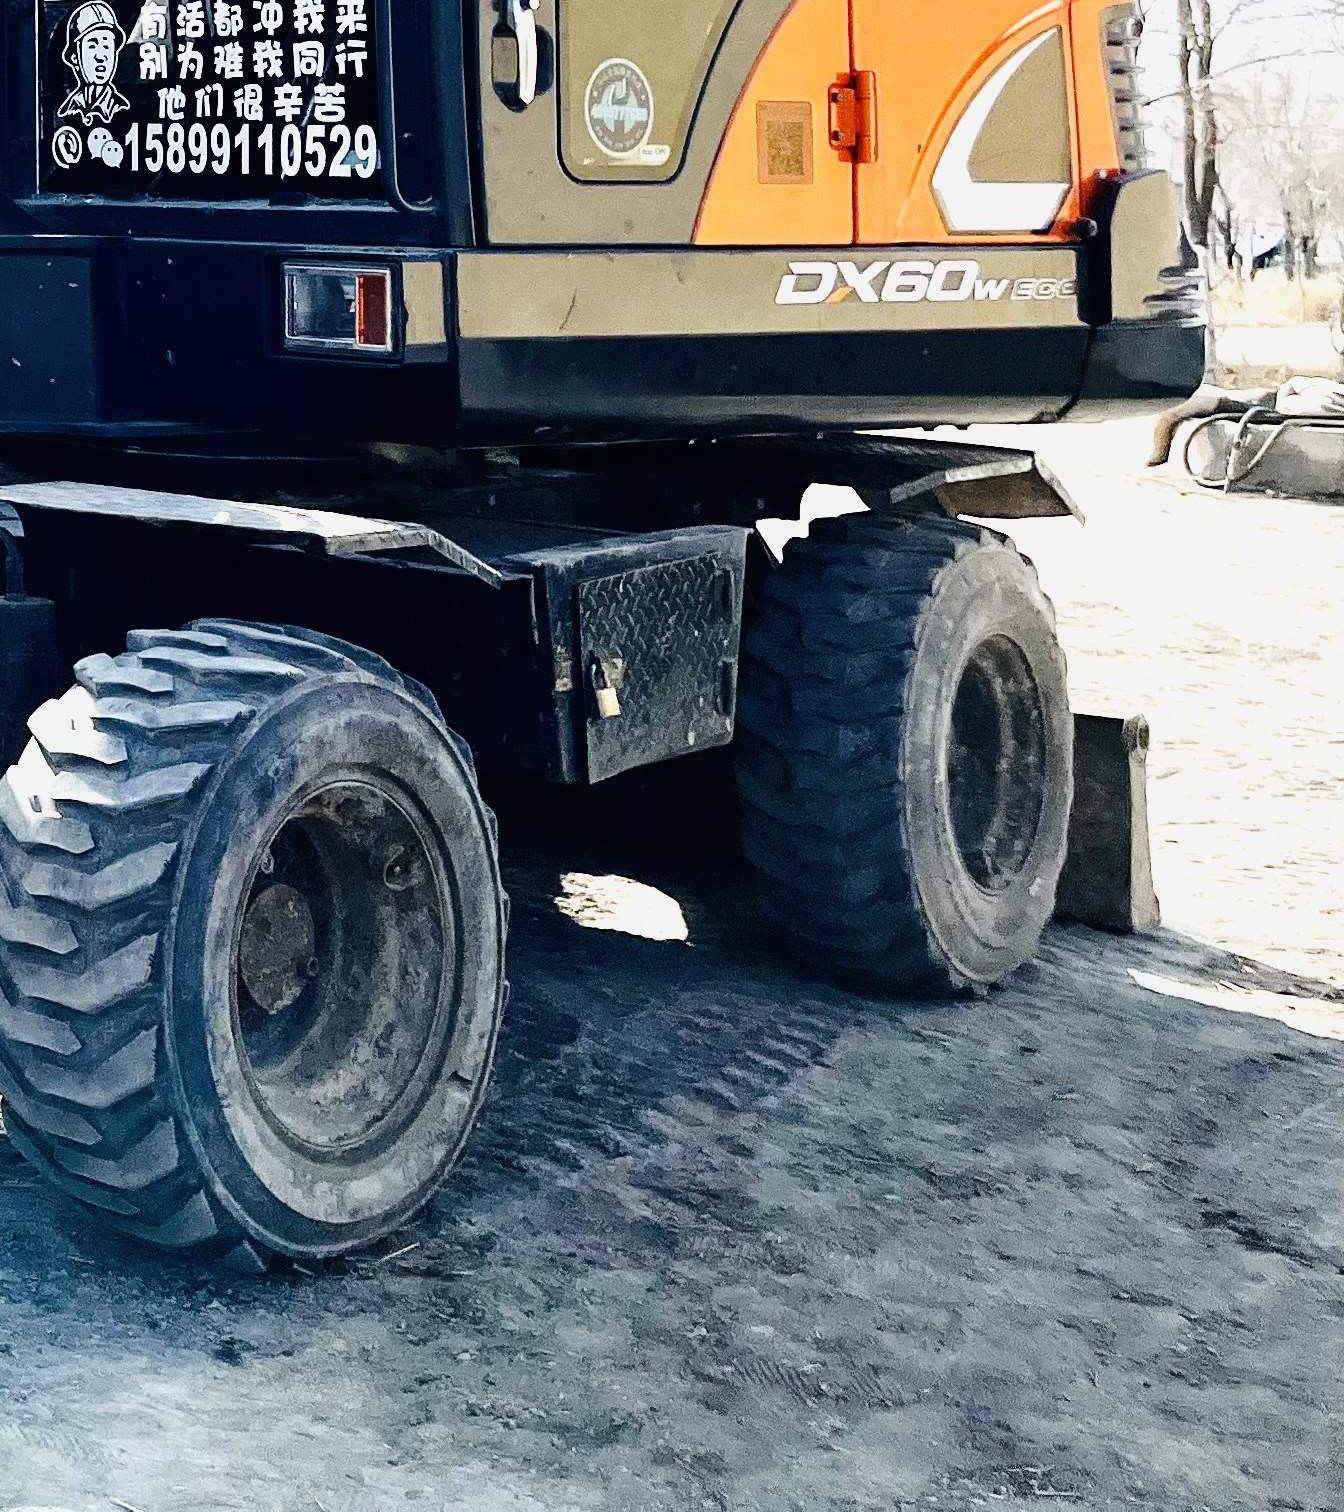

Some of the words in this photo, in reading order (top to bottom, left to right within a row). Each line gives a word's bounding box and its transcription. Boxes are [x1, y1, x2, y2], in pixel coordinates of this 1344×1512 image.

[139, 40, 368, 80] 别为难我同行
[157, 83, 346, 122] 他们很辛苦
[125, 122, 377, 179] 15899110529
